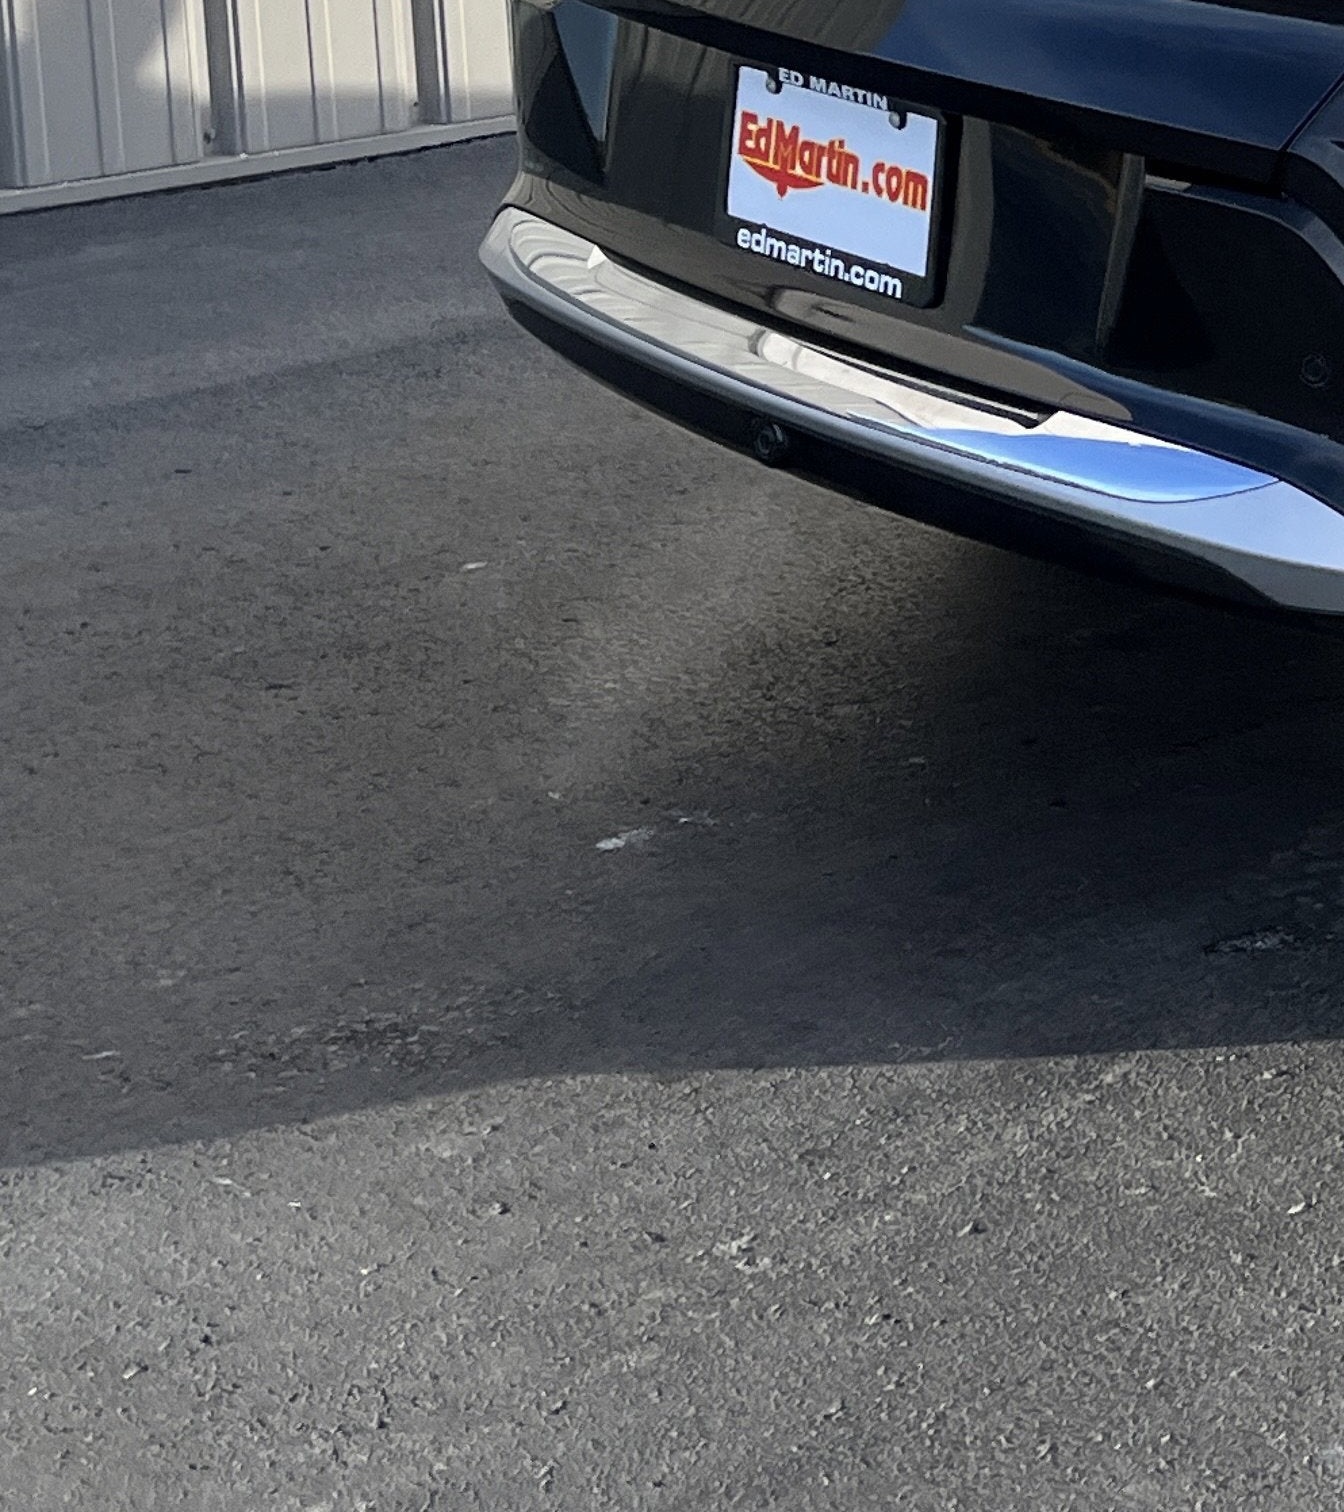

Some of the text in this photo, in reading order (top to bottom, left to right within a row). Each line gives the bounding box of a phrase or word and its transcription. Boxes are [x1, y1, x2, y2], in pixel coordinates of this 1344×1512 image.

[778, 67, 889, 111] ED MARTIN
[738, 110, 928, 212] EdMartin.com
[737, 227, 902, 299] edmartin.com
